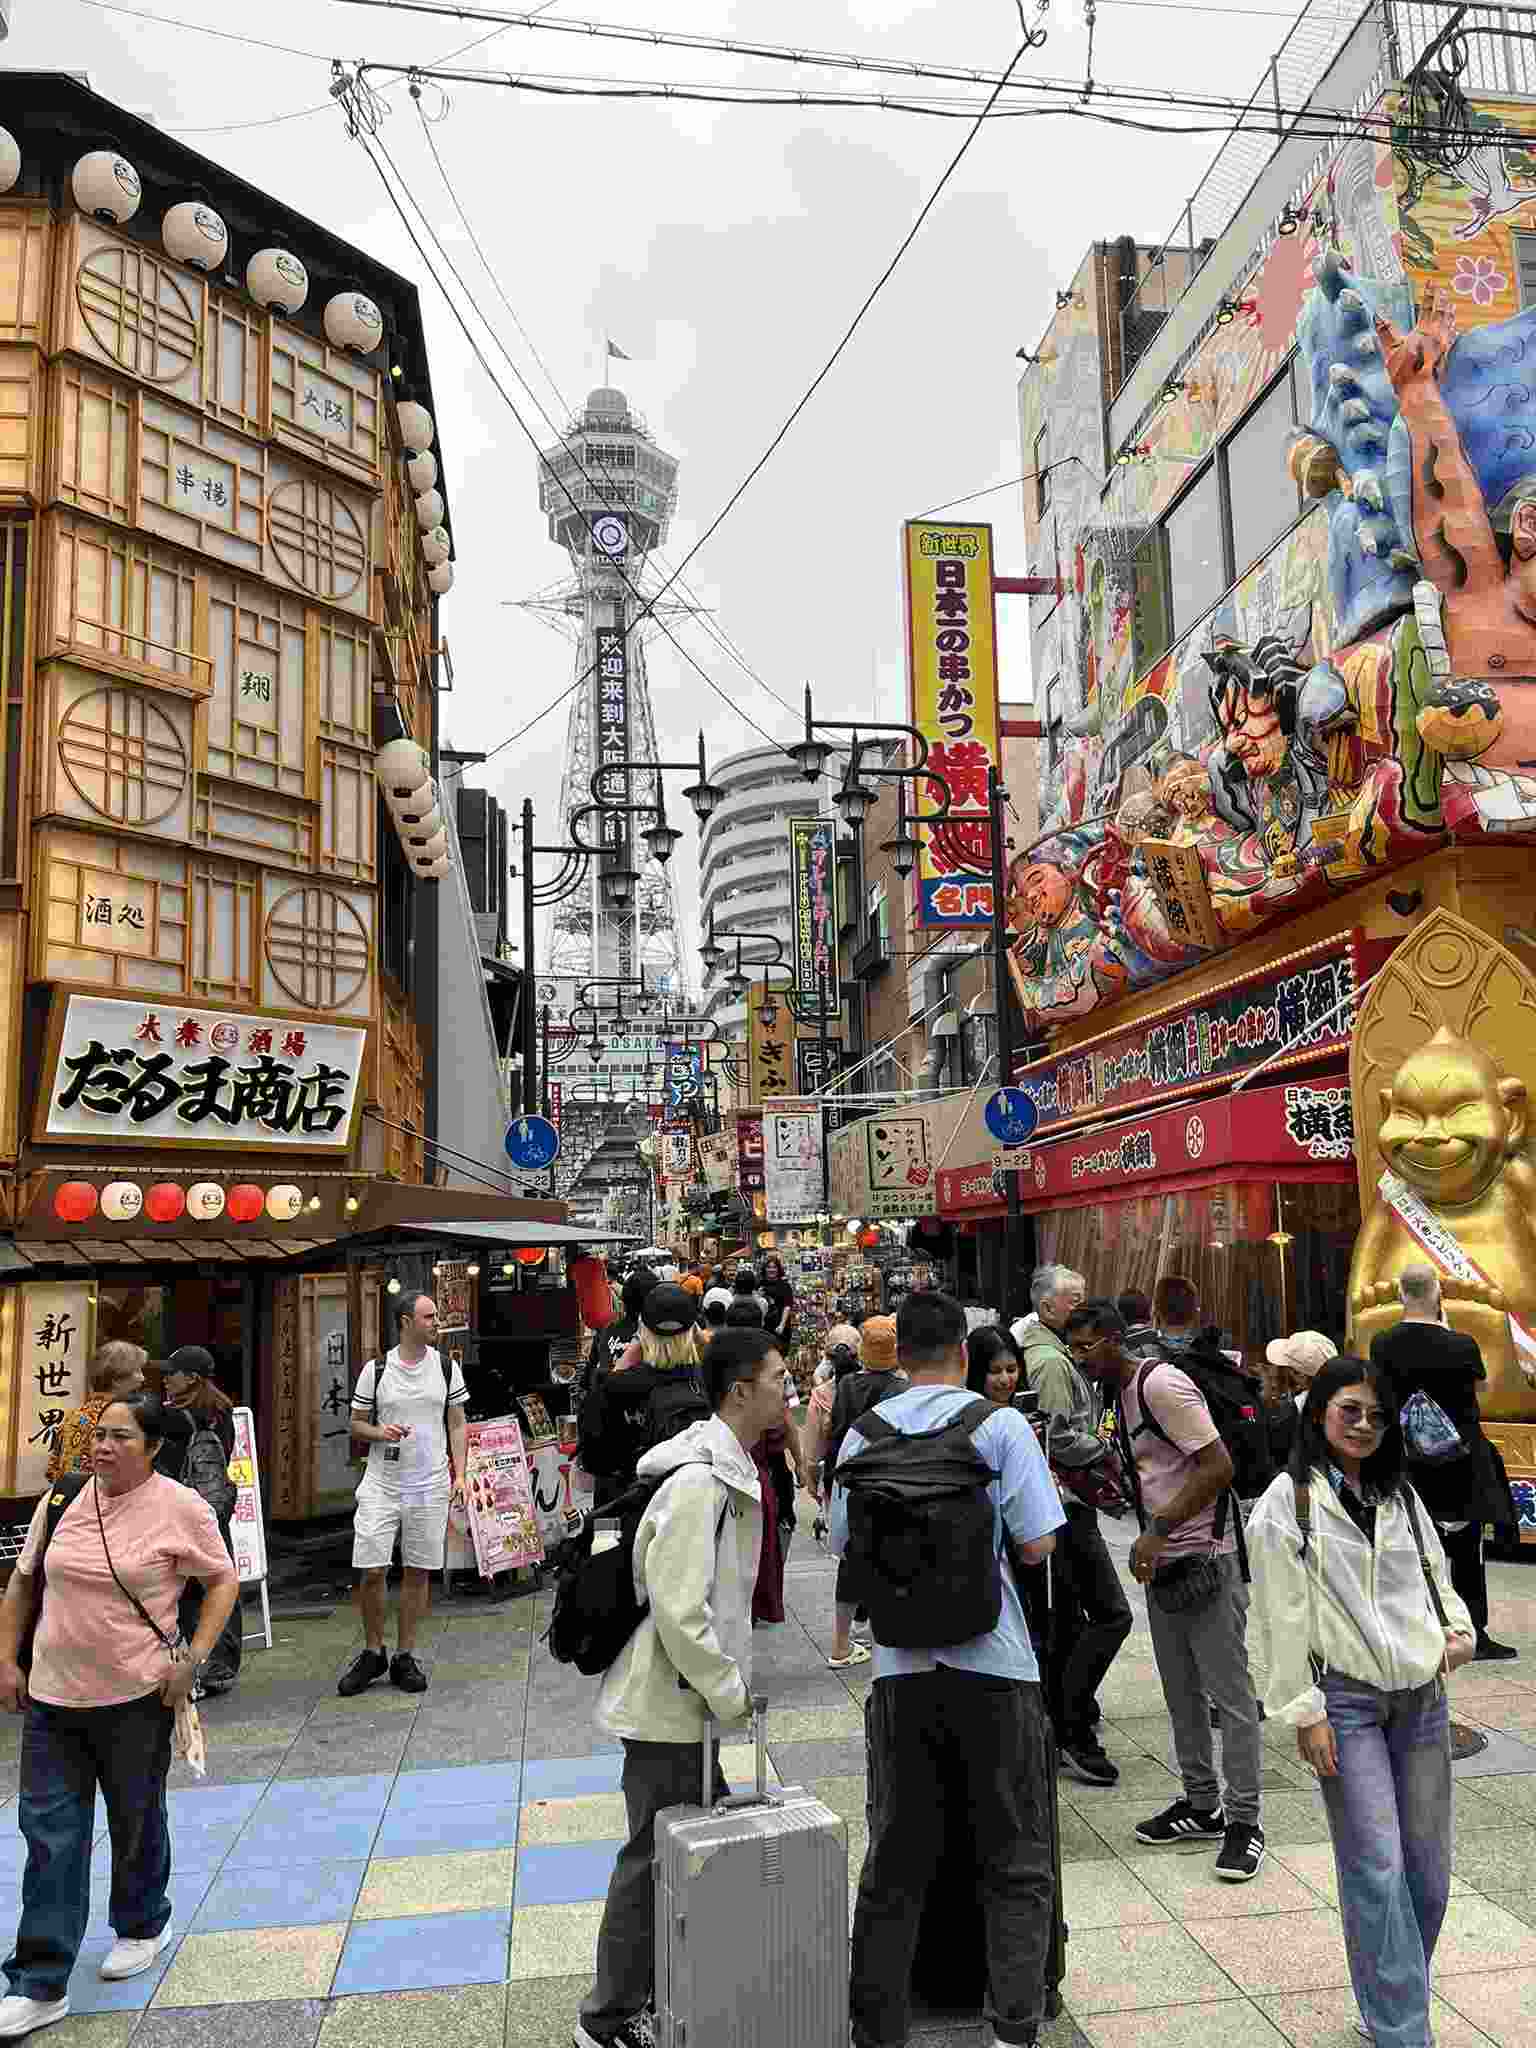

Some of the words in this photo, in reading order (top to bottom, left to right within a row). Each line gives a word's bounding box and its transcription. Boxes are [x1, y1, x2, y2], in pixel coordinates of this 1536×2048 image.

[302, 388, 347, 432] 大阪
[935, 560, 973, 738] 日本一の串かつ
[239, 671, 271, 703] 翔
[84, 893, 145, 930] 酒処
[57, 1040, 350, 1133] だるま商店
[28, 1312, 77, 1454] 新世界
